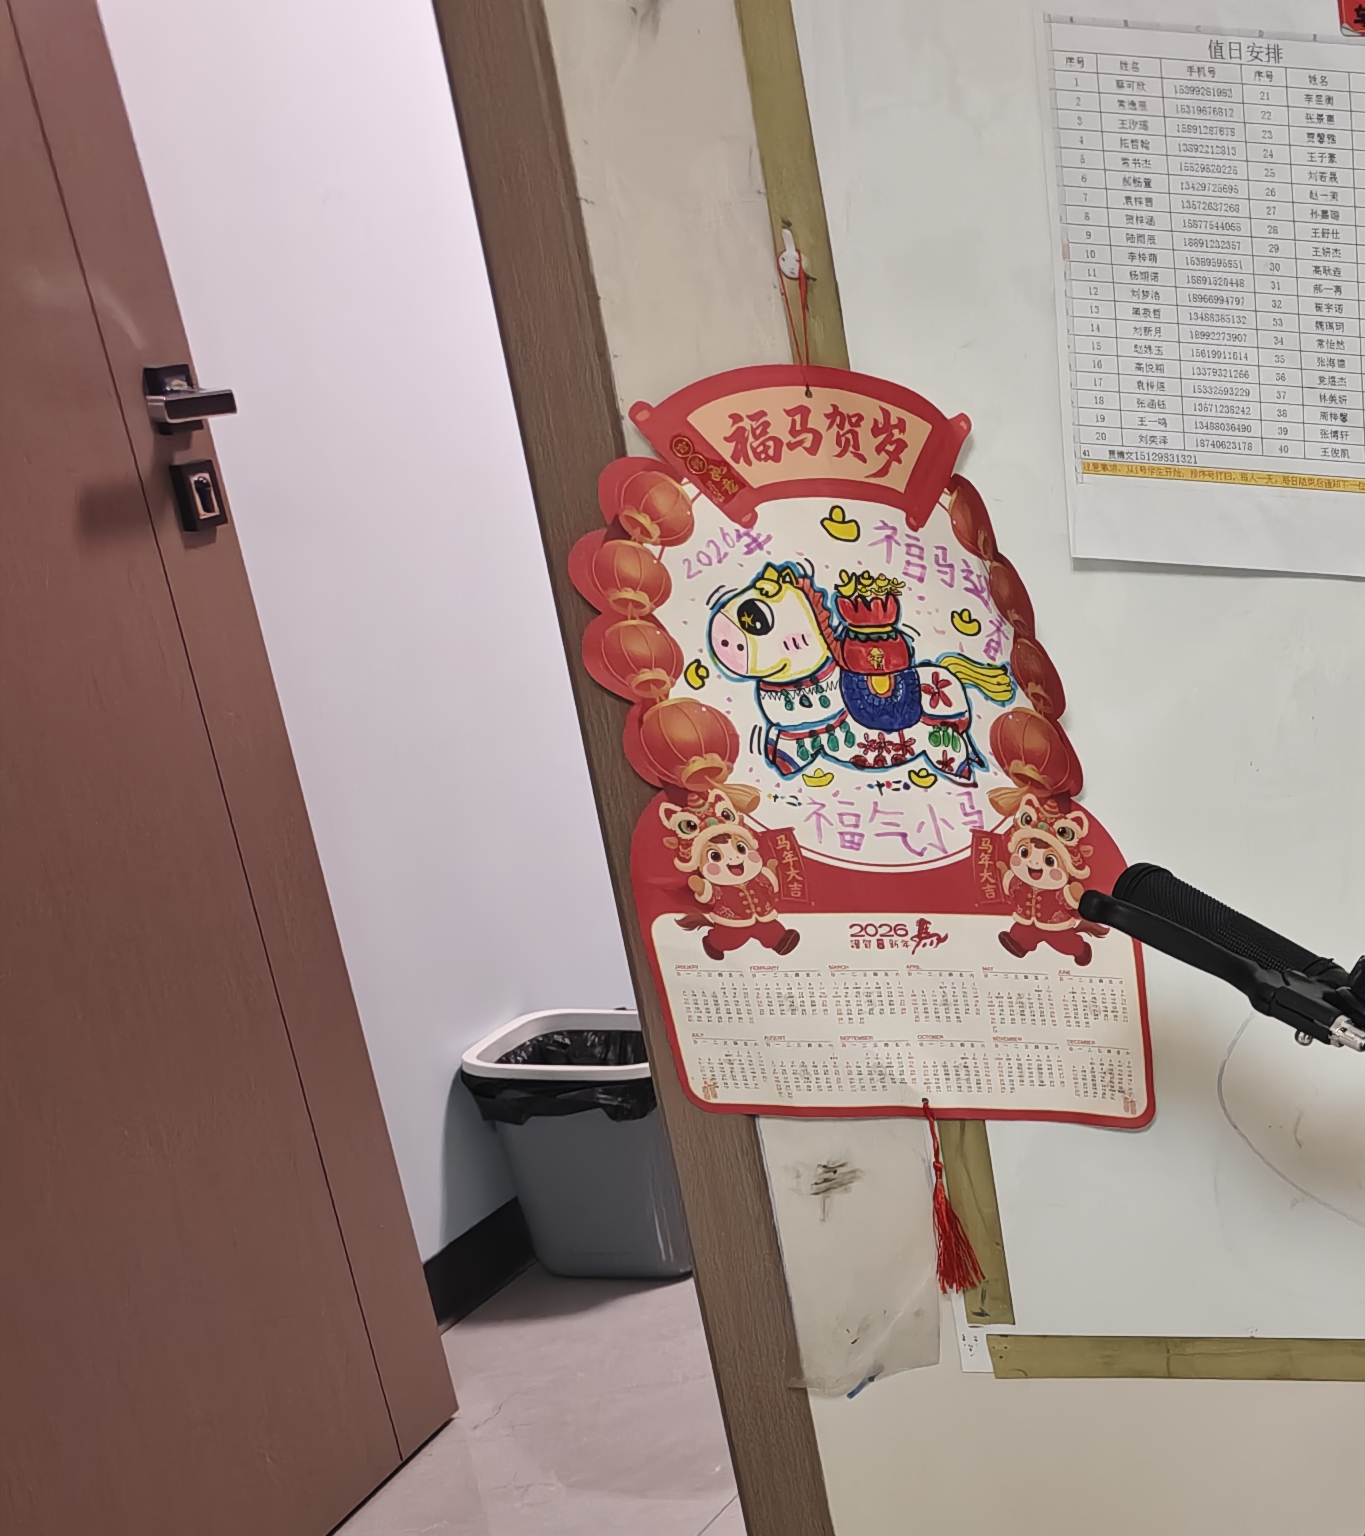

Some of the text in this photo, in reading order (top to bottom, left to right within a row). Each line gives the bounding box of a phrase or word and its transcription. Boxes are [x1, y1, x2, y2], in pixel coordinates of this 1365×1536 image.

[1188, 66, 1215, 77] 手机号
[1208, 39, 1284, 63] 值日安排
[723, 404, 909, 479] 福马贺岁
[804, 790, 984, 857] 福气小马
[776, 834, 803, 898] 马年大吉
[977, 838, 996, 899] 马年大吉
[849, 923, 908, 937] 2026
